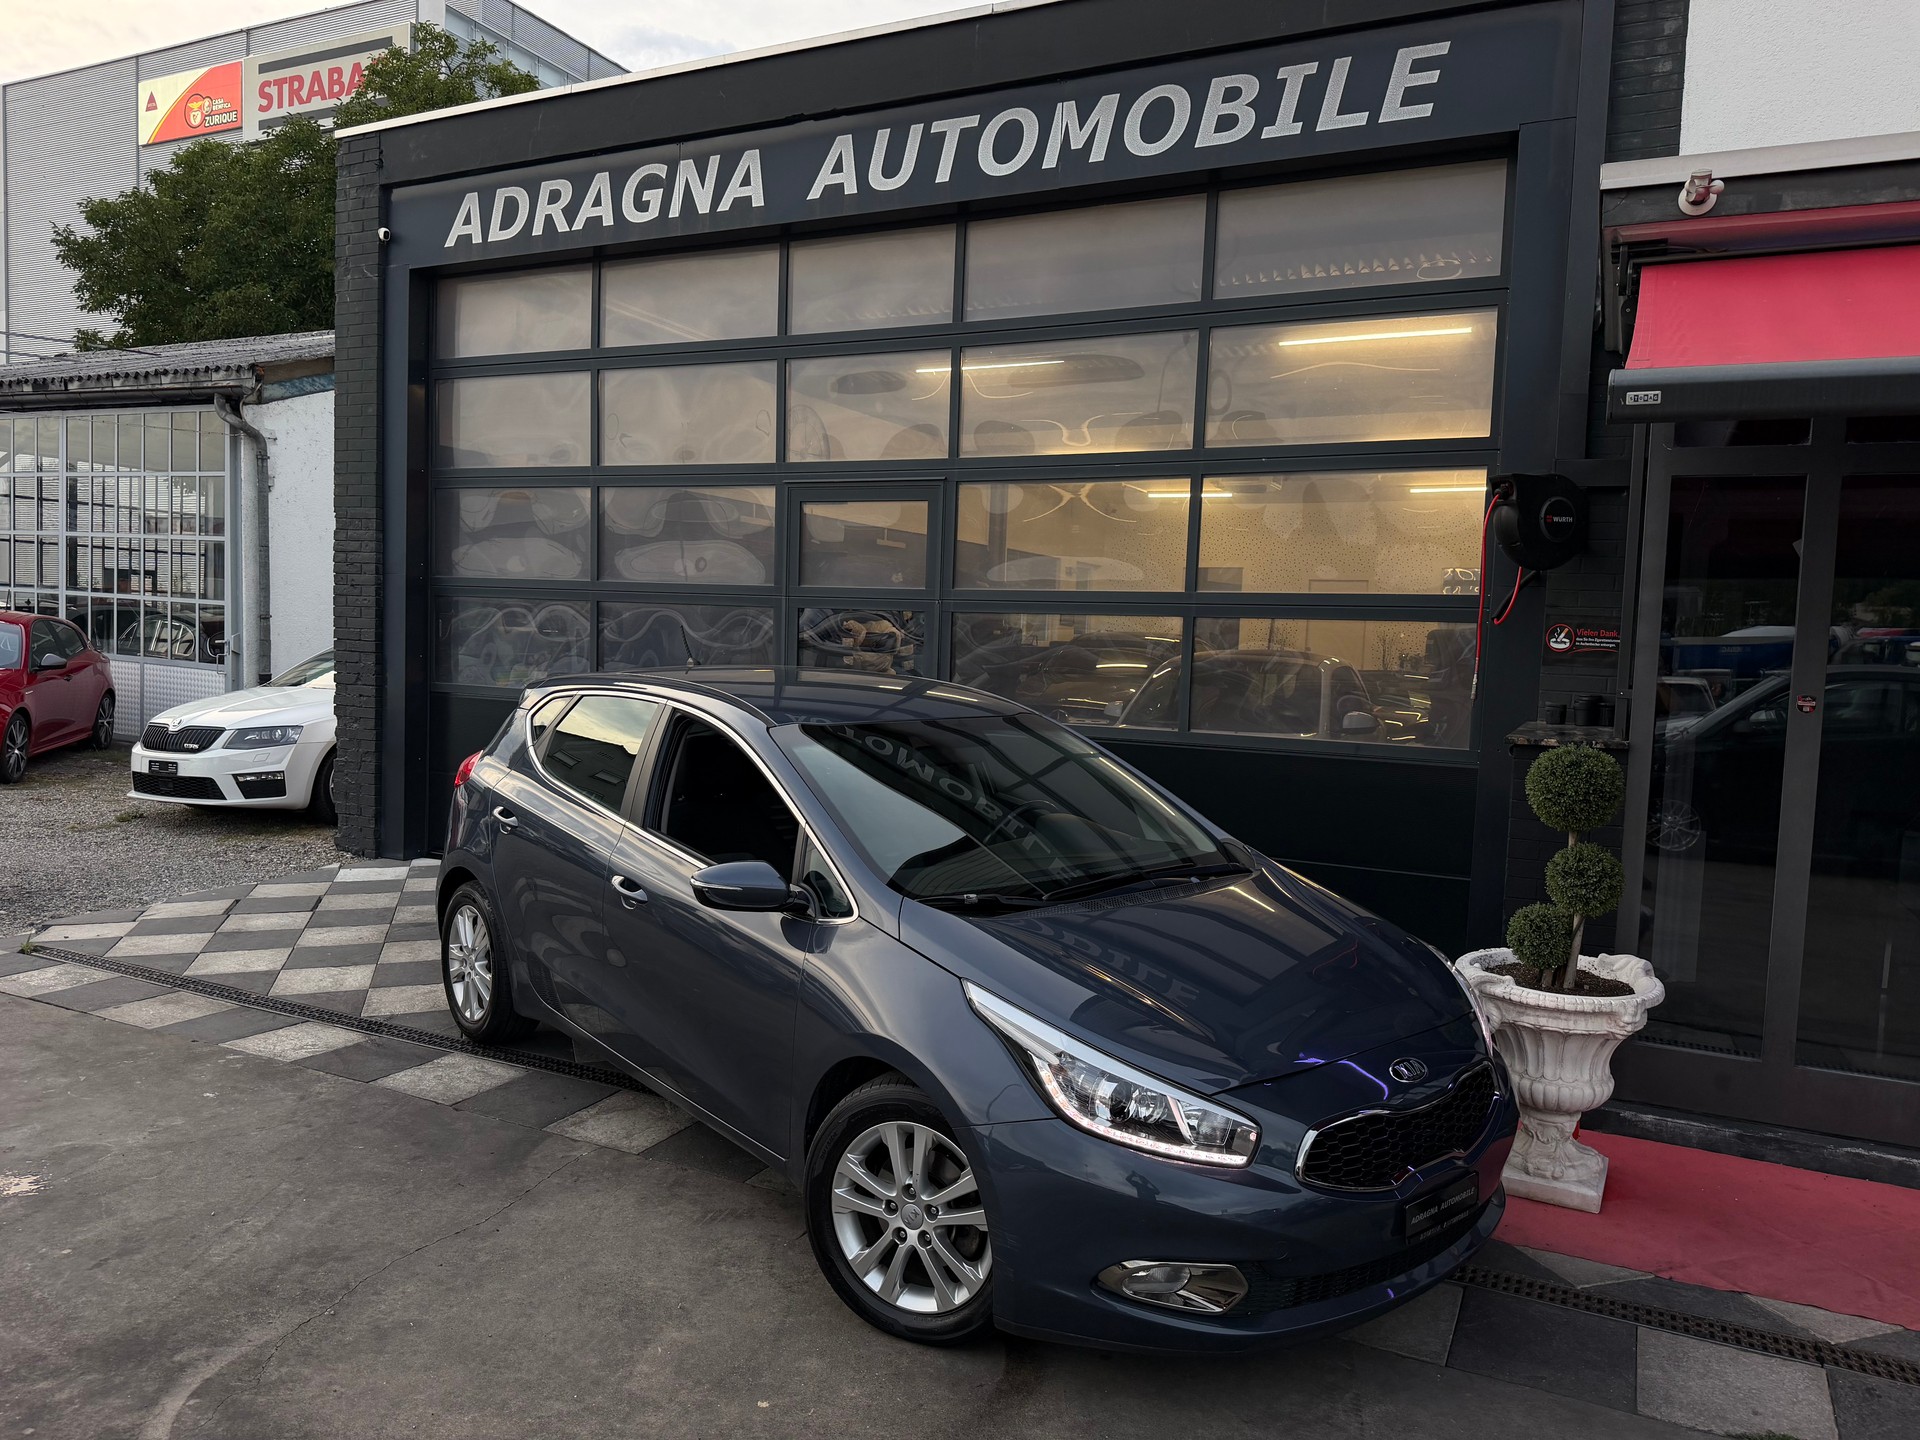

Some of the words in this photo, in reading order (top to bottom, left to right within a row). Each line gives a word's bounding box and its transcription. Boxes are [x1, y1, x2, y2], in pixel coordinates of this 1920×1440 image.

[258, 57, 380, 113] STRABA
[204, 111, 238, 127] ZURIQUE
[444, 149, 765, 247] ADRAGNA
[806, 41, 1451, 200] AUTOMOBILE
[1576, 628, 1599, 637] Vielen
[1394, 1060, 1425, 1079] KIA
[1411, 1205, 1439, 1225] ADRAGNA
[1440, 1186, 1475, 1210] AUTOMOBILE
[904, 1208, 920, 1226] KIA
